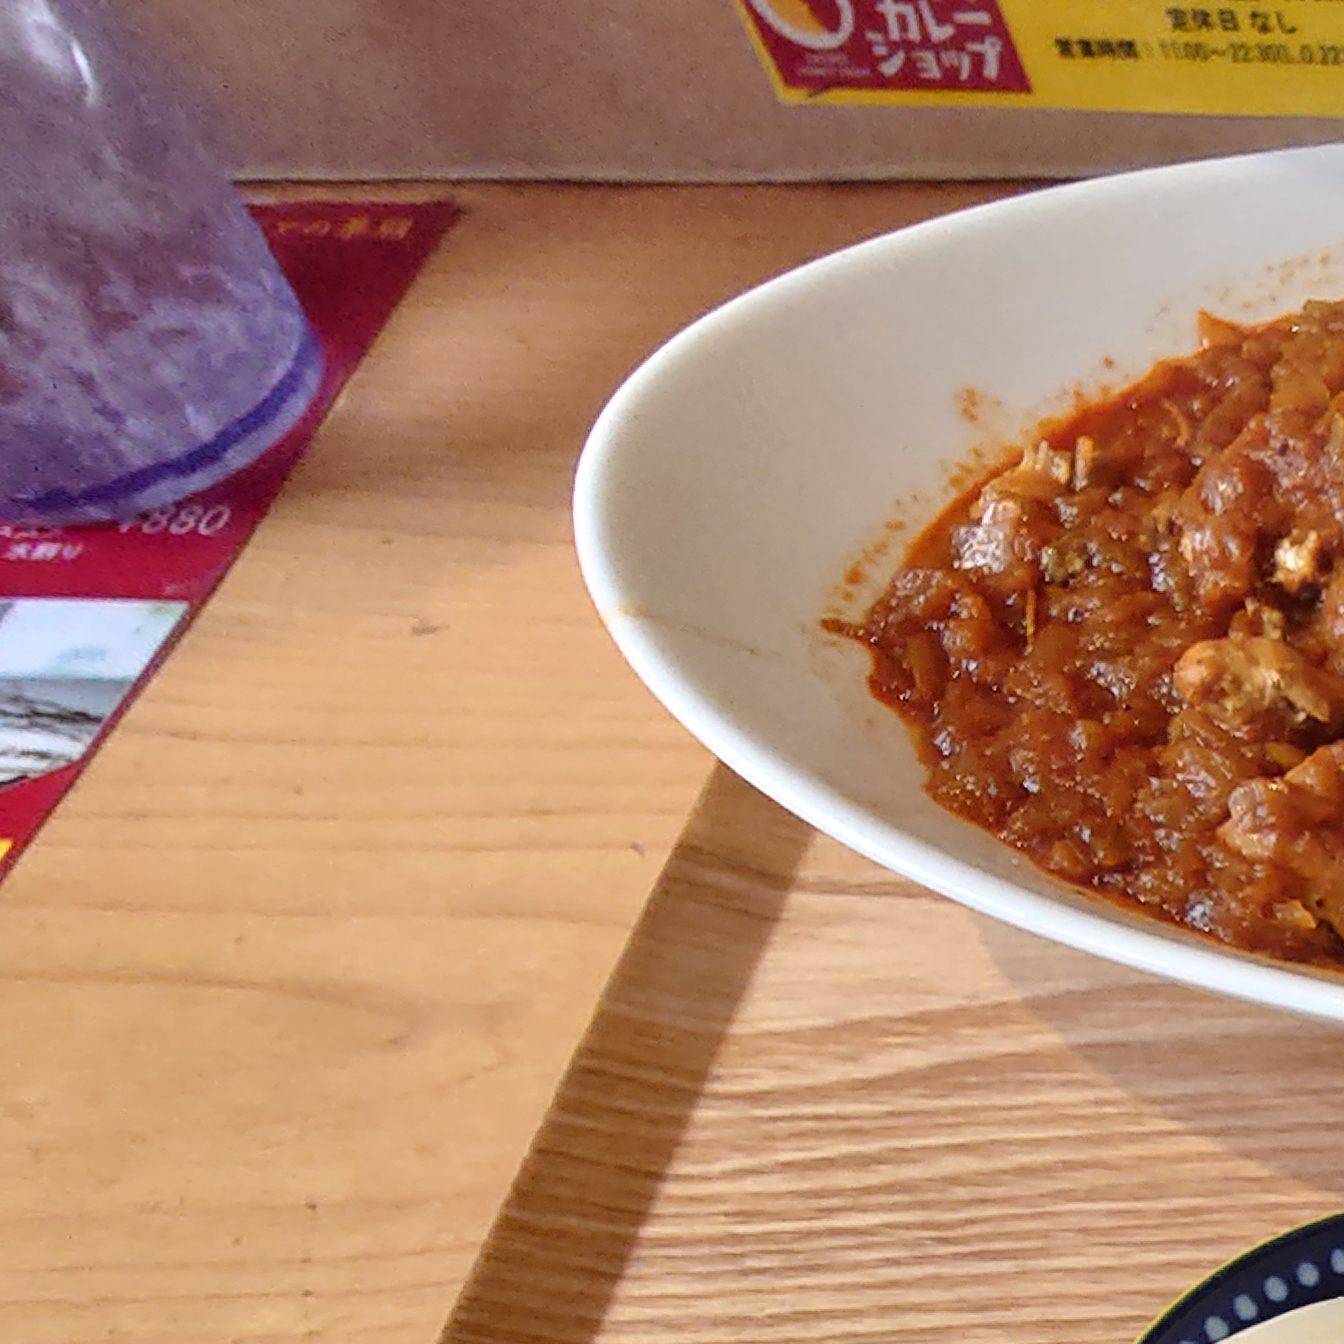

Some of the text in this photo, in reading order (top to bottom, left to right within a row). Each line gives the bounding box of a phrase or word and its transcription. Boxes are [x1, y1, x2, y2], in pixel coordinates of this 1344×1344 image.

[875, 0, 992, 42] カレー
[865, 31, 1002, 81] ショップ
[118, 505, 232, 536] 880
